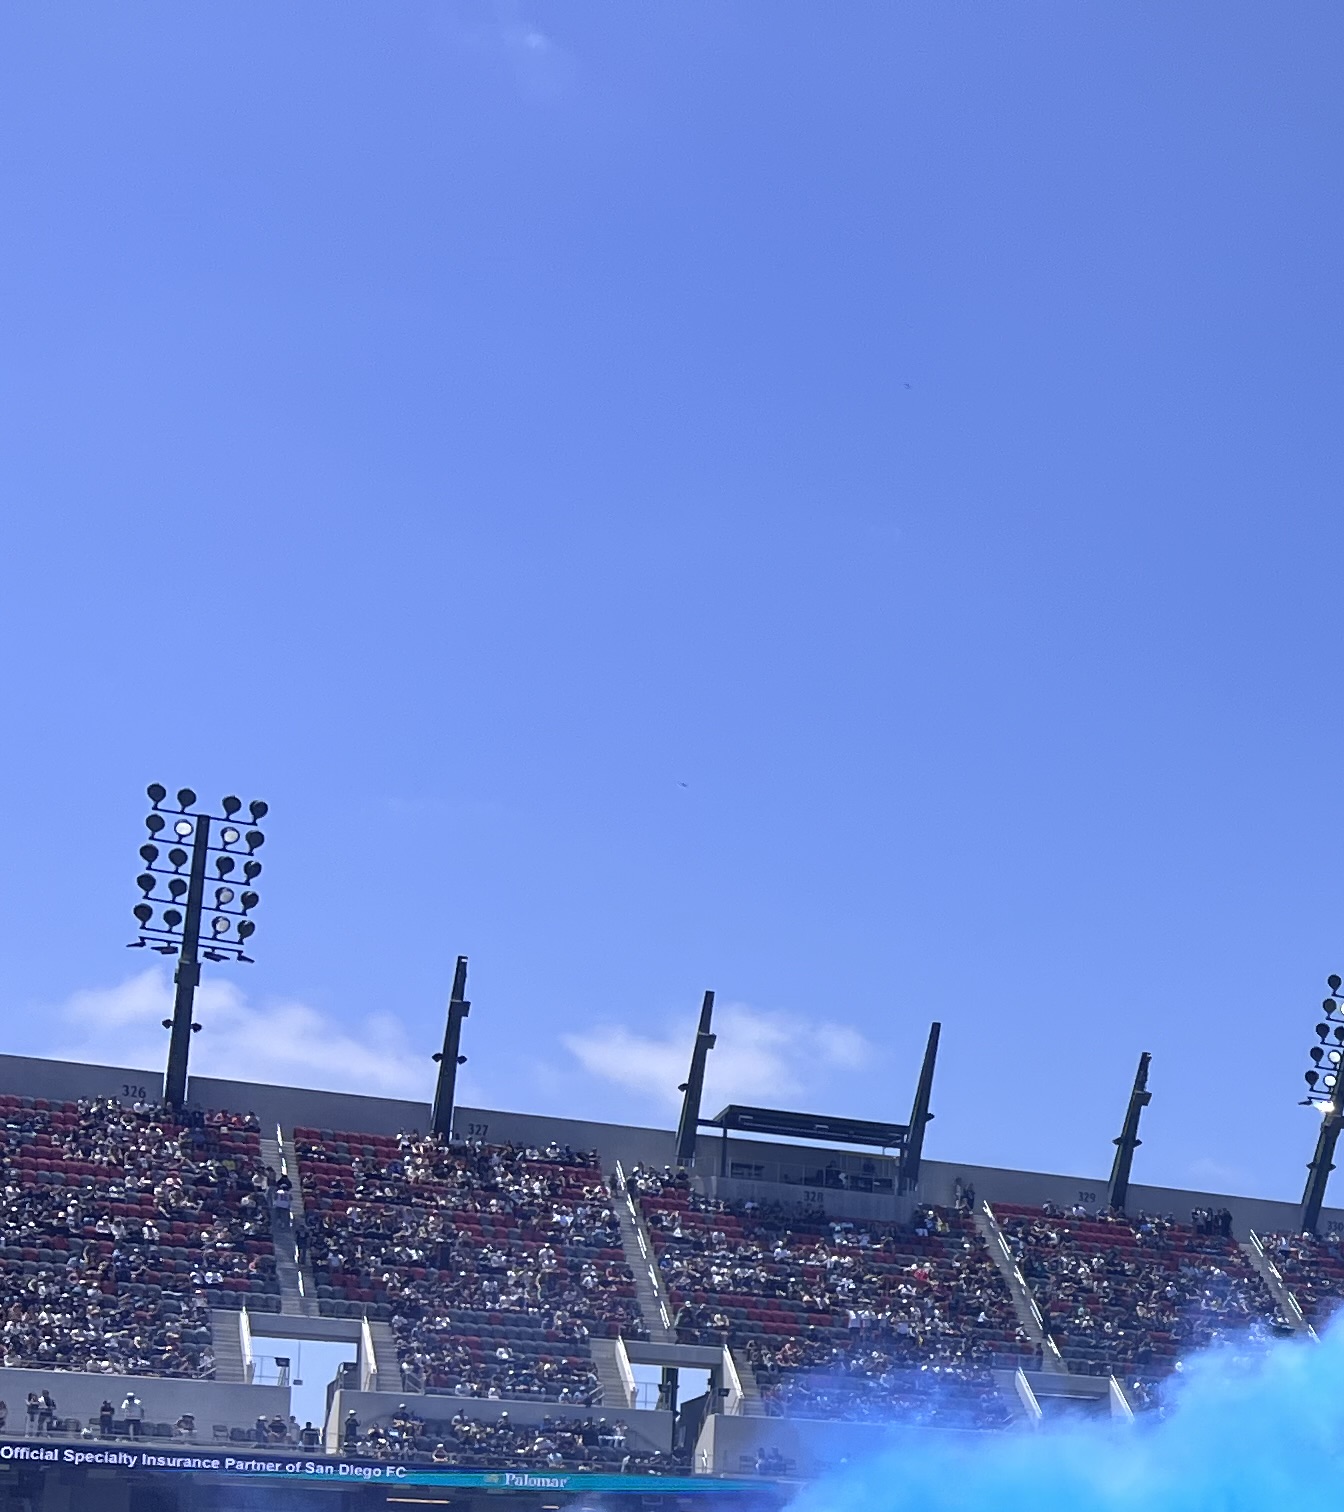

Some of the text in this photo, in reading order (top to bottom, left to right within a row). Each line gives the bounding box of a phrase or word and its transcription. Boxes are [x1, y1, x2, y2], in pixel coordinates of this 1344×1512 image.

[121, 1084, 147, 1099] 326
[467, 1123, 489, 1136] 327
[0, 1445, 407, 1480] Official Specialty Insurance Partner of San Diego FC
[504, 1473, 568, 1489] Palomar
